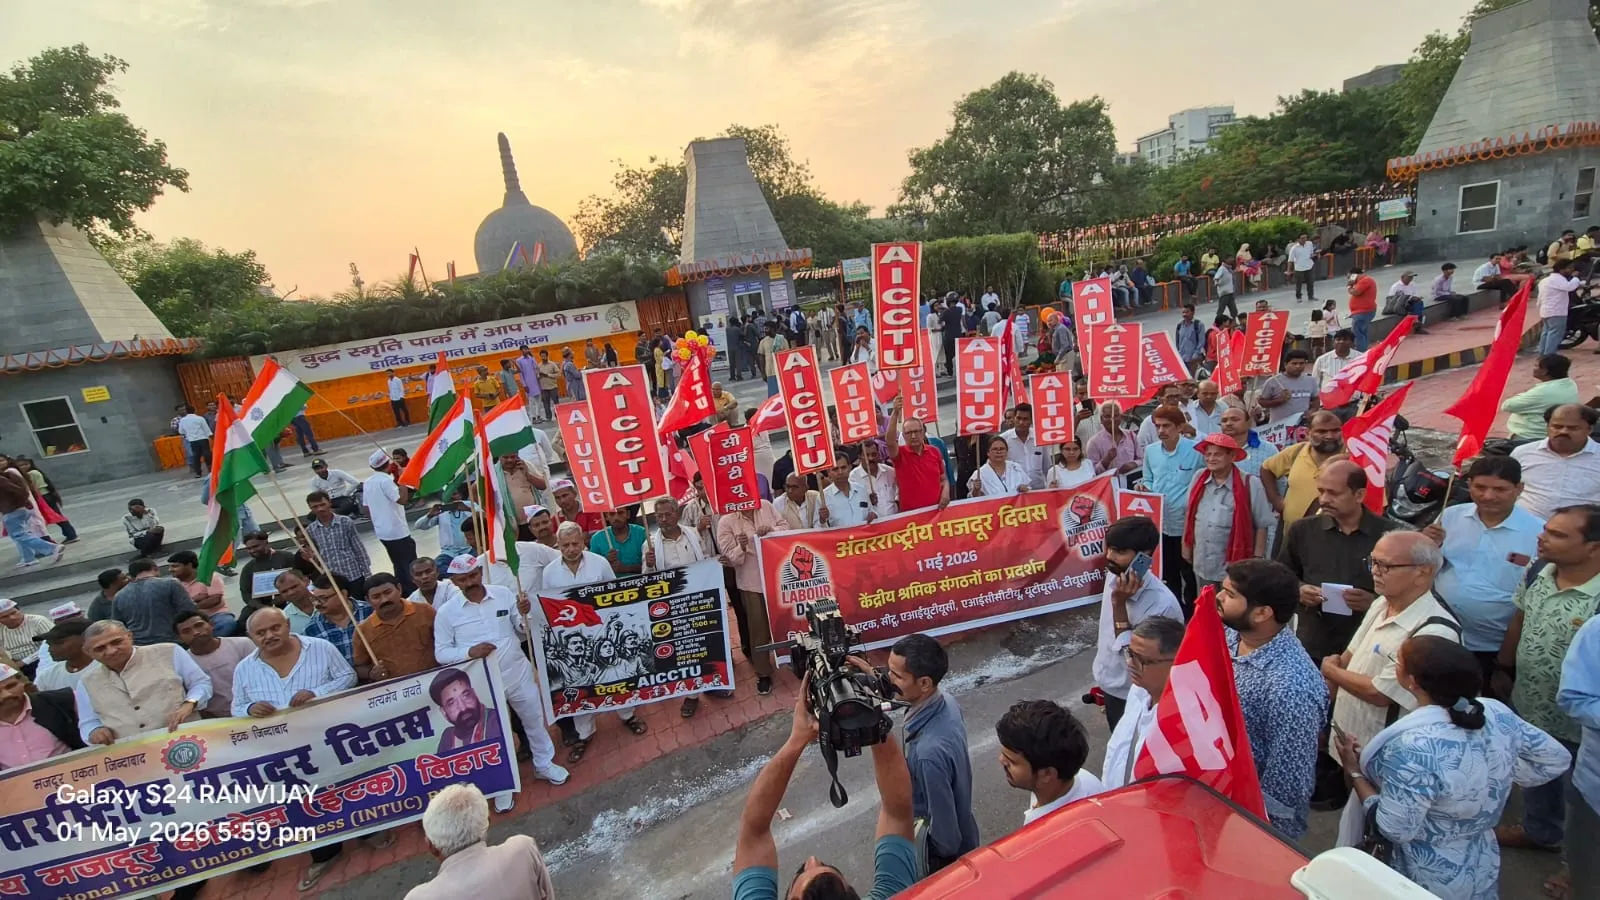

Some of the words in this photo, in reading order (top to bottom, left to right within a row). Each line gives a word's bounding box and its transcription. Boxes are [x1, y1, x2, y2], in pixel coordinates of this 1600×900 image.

[879, 246, 915, 366] AICCTU
[300, 349, 341, 369] बुद्ध
[346, 338, 403, 358] स्मृति
[409, 329, 452, 348] पार्क
[459, 326, 480, 341] में
[483, 323, 522, 337] आप
[527, 313, 568, 330] सभी
[572, 311, 600, 323] का
[369, 355, 414, 370] हार्दिक
[418, 347, 465, 362] स्वगत
[468, 342, 487, 355] एवं
[490, 334, 549, 352] अभिनंदन
[1103, 324, 1128, 383] AICCTU
[1251, 312, 1279, 362] AICCTU
[839, 368, 872, 439] AITUC
[908, 366, 929, 420] UTUC
[963, 338, 995, 434] AIUTUC
[783, 351, 828, 469] AICCTU
[1038, 375, 1067, 442] AITUC
[602, 372, 652, 496] AICCTU
[718, 446, 749, 466] आई
[721, 433, 741, 449] सी
[568, 409, 605, 505] AIUTUC
[728, 465, 743, 480] टी
[725, 500, 756, 513] बिहार
[835, 521, 934, 559] अंतरराष्ट्रीय
[937, 513, 994, 542] मजदूर
[998, 503, 1049, 529] दिवस
[1081, 541, 1104, 557] DAY
[916, 560, 924, 572] 1
[925, 553, 945, 571] मई
[946, 549, 978, 567] 2026
[577, 584, 604, 598] दुनिया
[607, 581, 616, 590] के
[593, 588, 640, 607] एक
[645, 580, 670, 599] हो
[781, 576, 829, 591] INTERNATIONAL
[782, 585, 831, 603] LABOUR
[858, 585, 896, 610] केंद्रीय
[898, 578, 938, 601] श्रमिक
[939, 568, 983, 592] संगठनों
[984, 566, 1003, 583] का
[1004, 558, 1047, 579] प्रदर्शन
[880, 613, 899, 628] सीटू,
[368, 688, 398, 709] सत्यमेव
[402, 680, 422, 699] जयते
[637, 665, 702, 689] AICCTU
[230, 726, 250, 747] इंटक
[252, 722, 288, 742] जिन्दाबाद
[324, 706, 436, 766] दिवस
[33, 772, 64, 791] मजदूर
[71, 764, 99, 782] एकता
[104, 752, 147, 773] जिन्दाबाद
[35, 842, 163, 888] मजदूर
[302, 764, 408, 818] (इंटक)
[415, 743, 502, 785] बिहार
[123, 859, 188, 886] Trade
[191, 843, 255, 870] Union
[258, 816, 345, 851] Coess
[350, 797, 423, 828] (INTUC)
